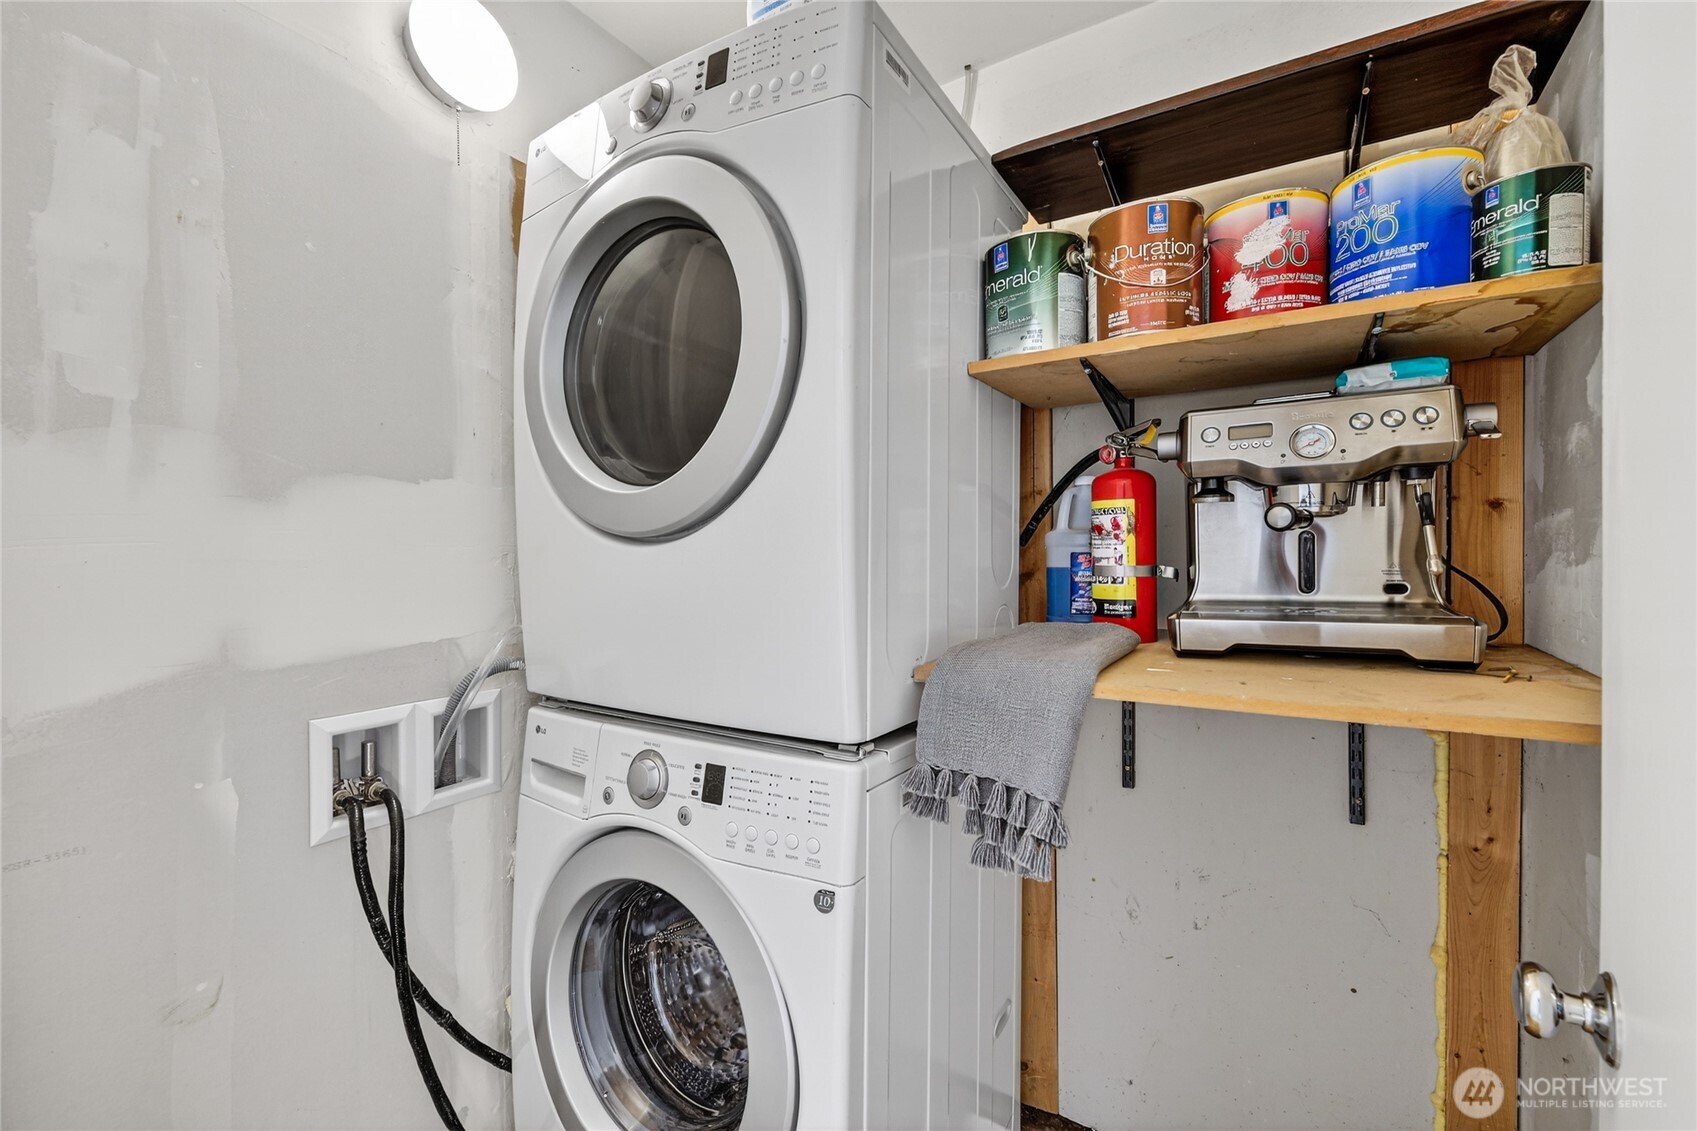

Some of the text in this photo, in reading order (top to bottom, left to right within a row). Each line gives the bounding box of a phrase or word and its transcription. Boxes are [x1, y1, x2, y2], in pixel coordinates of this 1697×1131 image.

[1114, 238, 1196, 263] Duration
[1335, 215, 1399, 263] 200
[985, 265, 1041, 298] merald
